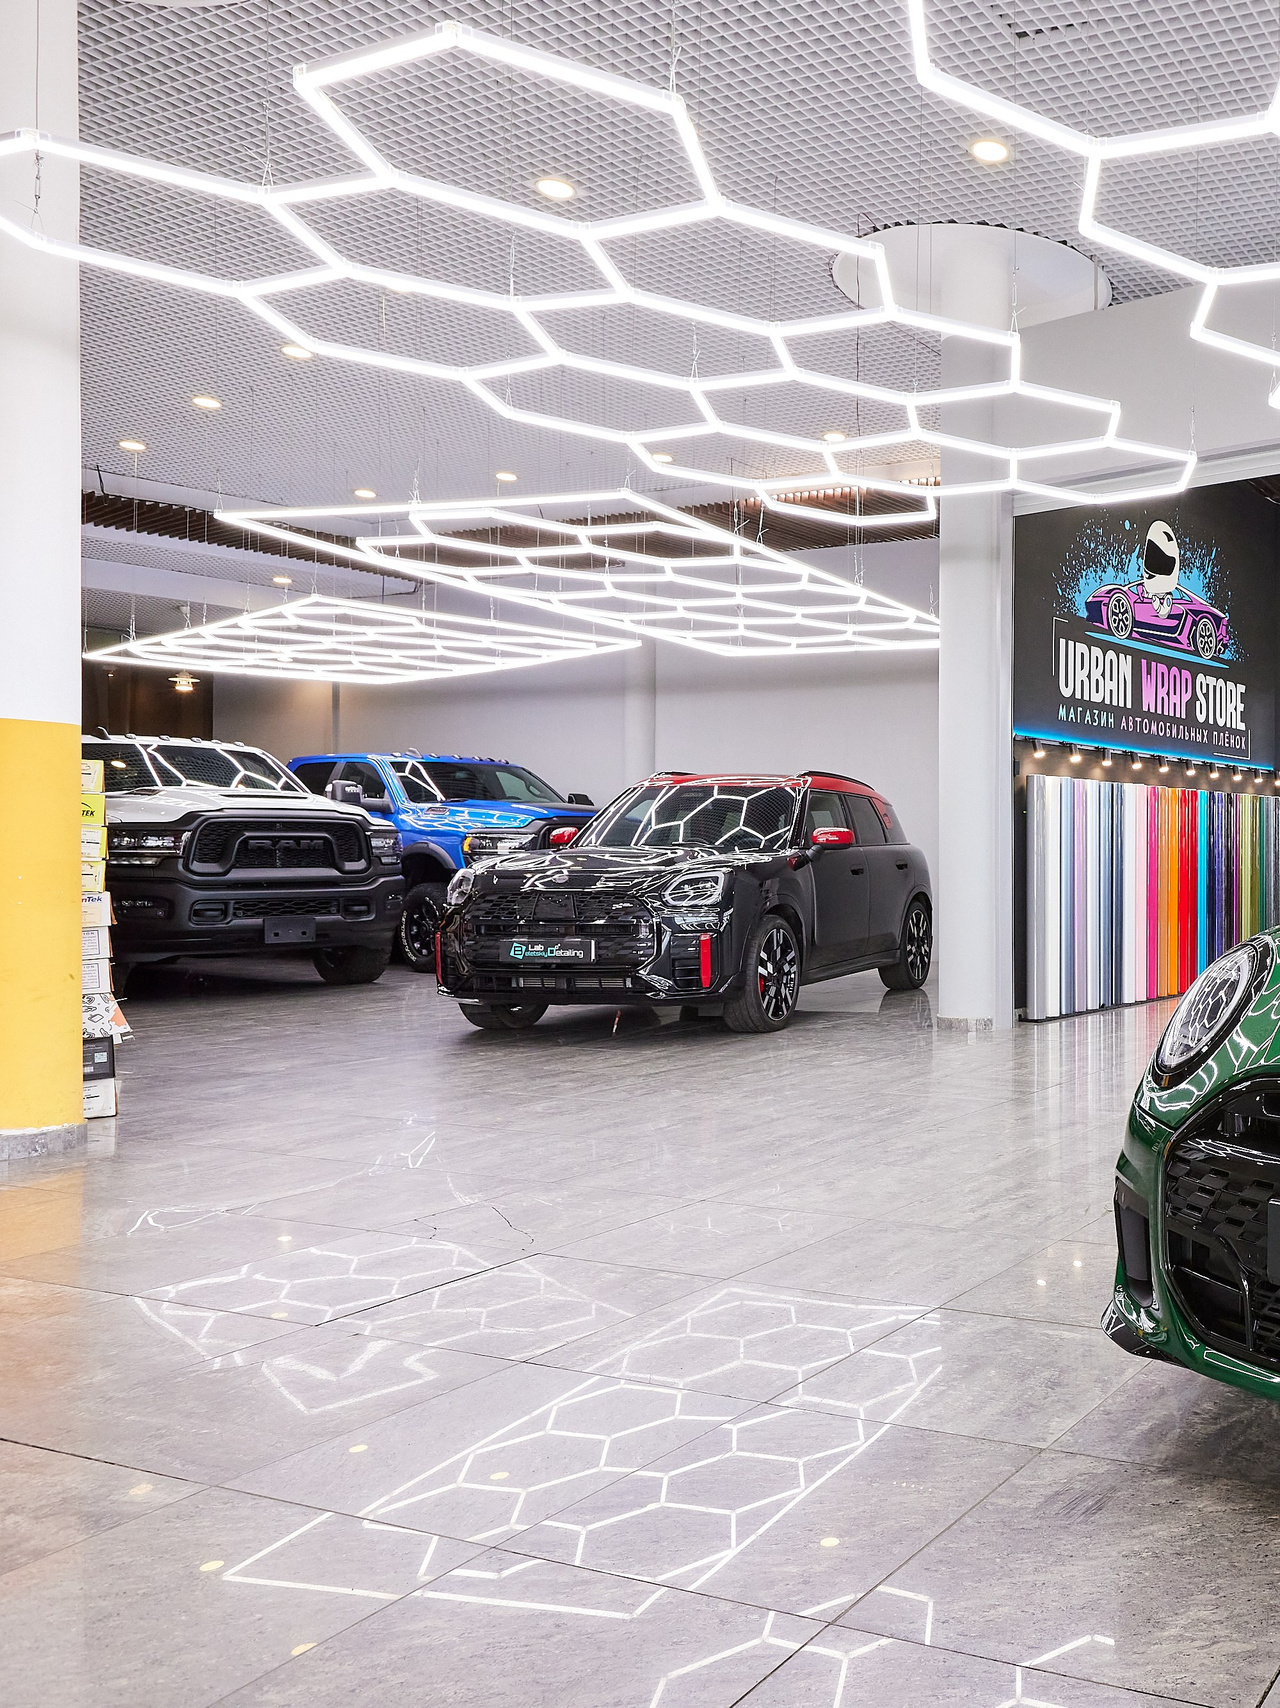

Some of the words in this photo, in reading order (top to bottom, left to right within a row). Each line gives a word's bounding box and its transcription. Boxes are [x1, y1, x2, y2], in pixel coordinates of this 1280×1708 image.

[1059, 638, 1132, 709] URBAN
[1141, 658, 1192, 719] WRAP
[1195, 673, 1246, 731] STORE
[1058, 704, 1114, 729] МАГАЗИН
[1121, 717, 1208, 744] АВТОМОБИЛЬНЫХ
[1213, 731, 1246, 750] ПЛЁНОК
[248, 840, 324, 850] RAM
